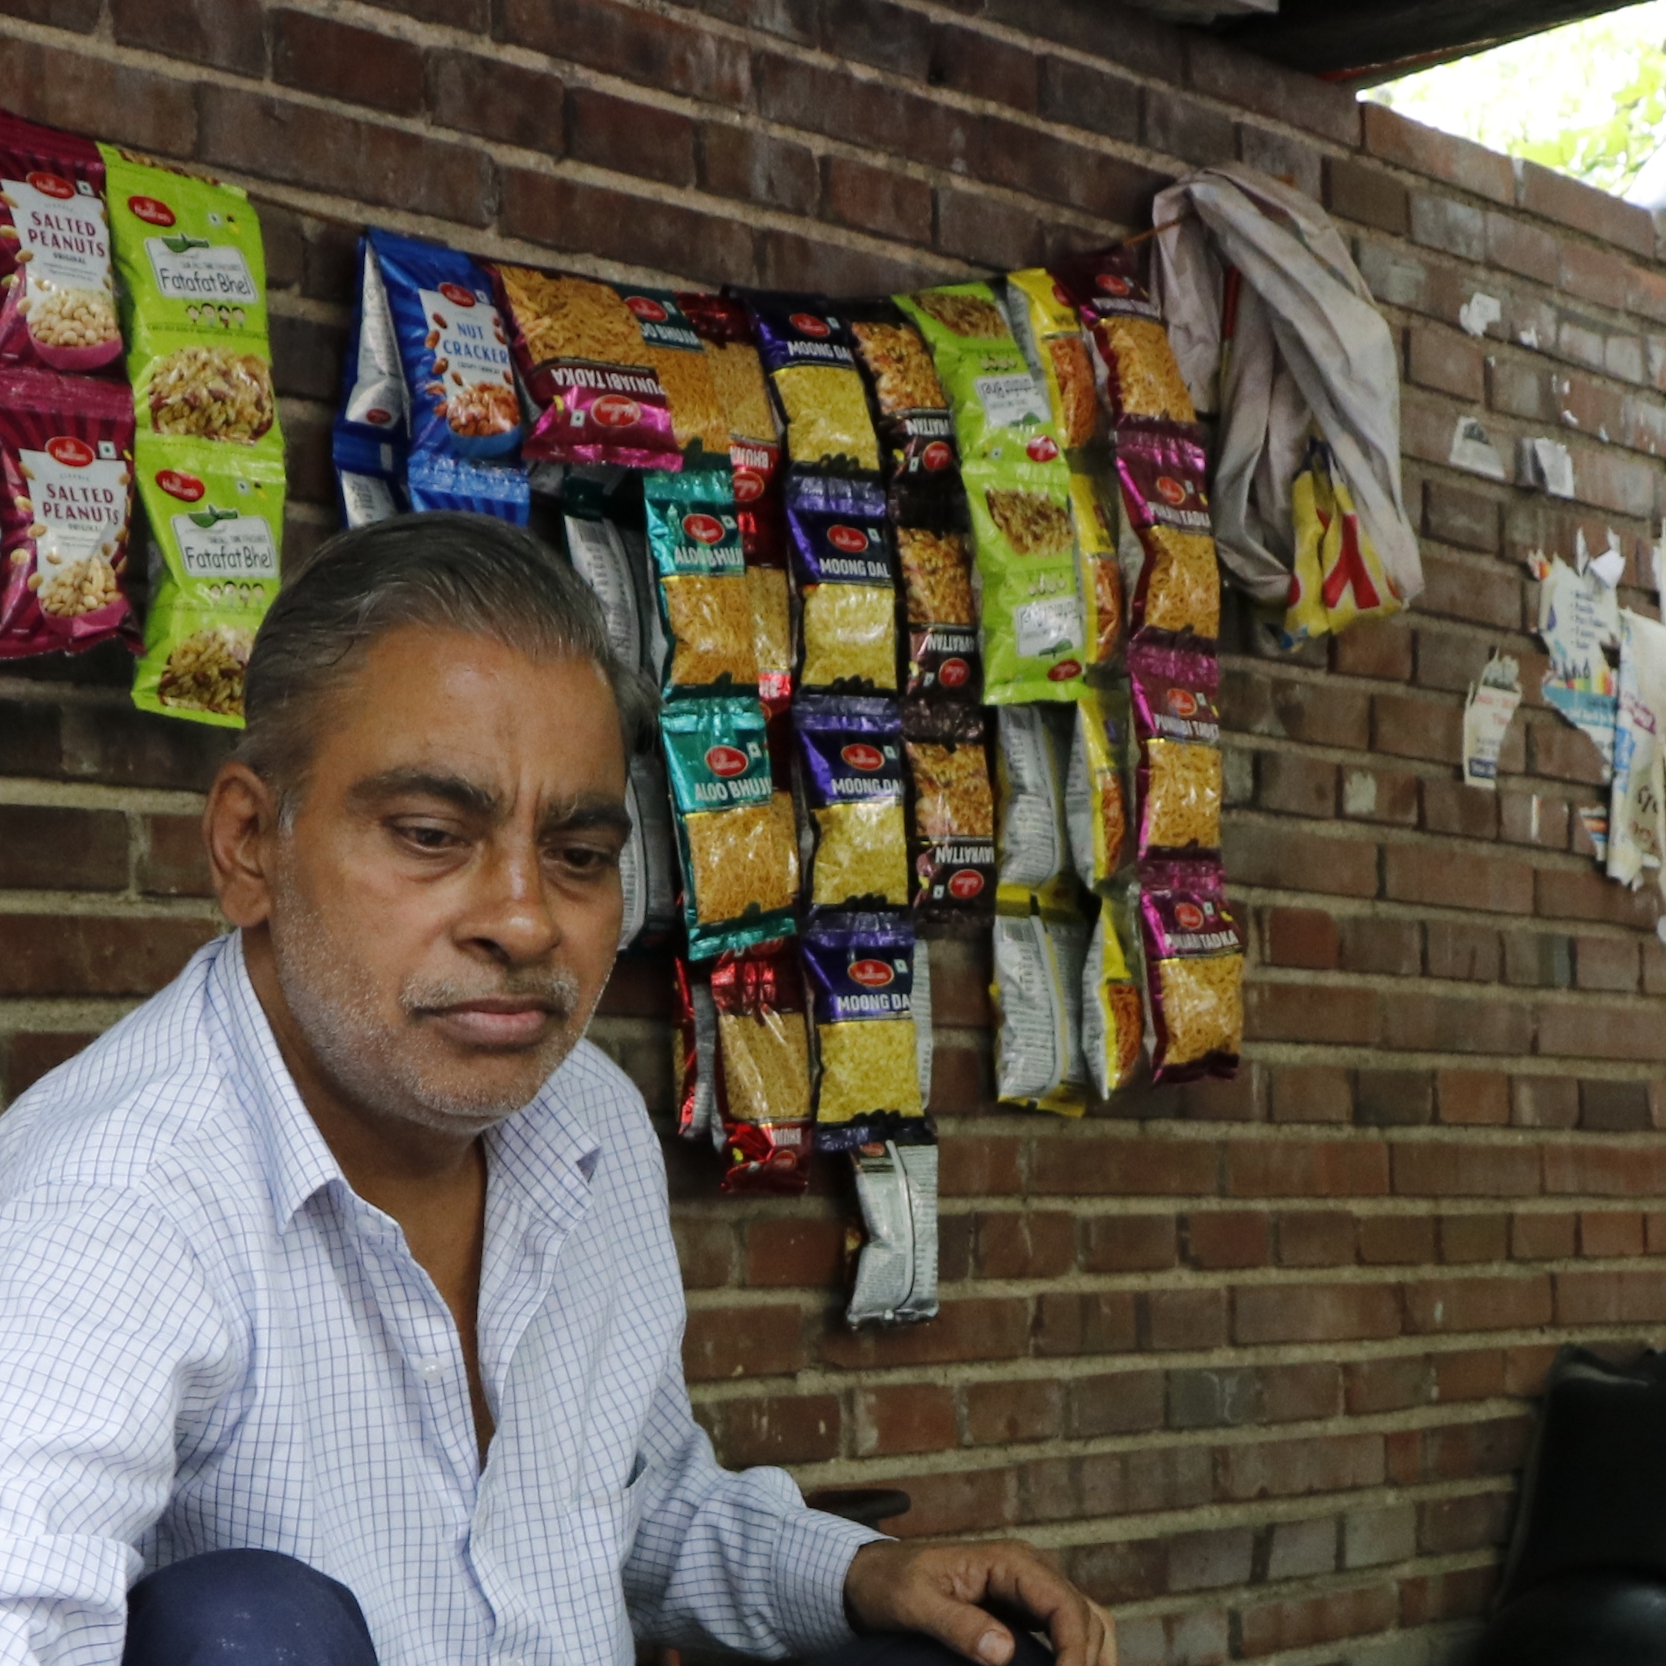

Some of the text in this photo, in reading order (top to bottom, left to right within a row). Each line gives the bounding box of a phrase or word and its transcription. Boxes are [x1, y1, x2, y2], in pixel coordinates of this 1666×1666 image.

[31, 211, 96, 237] SALTED
[27, 228, 106, 258] PEANUTS
[159, 268, 252, 295] Fatafat Bhel
[457, 322, 484, 340] NUT
[443, 339, 510, 365] CRACKER
[787, 341, 852, 360] MOONG DA
[550, 367, 606, 389] TADKA
[46, 483, 114, 504] SALTED
[42, 502, 120, 526] PEANUTS
[184, 545, 241, 571] Fatafat
[819, 558, 891, 579] MOONG DAL
[694, 777, 772, 801] ALOO BHUJI
[831, 778, 902, 795] MOONG DA
[837, 995, 912, 1012] MOONG DA
